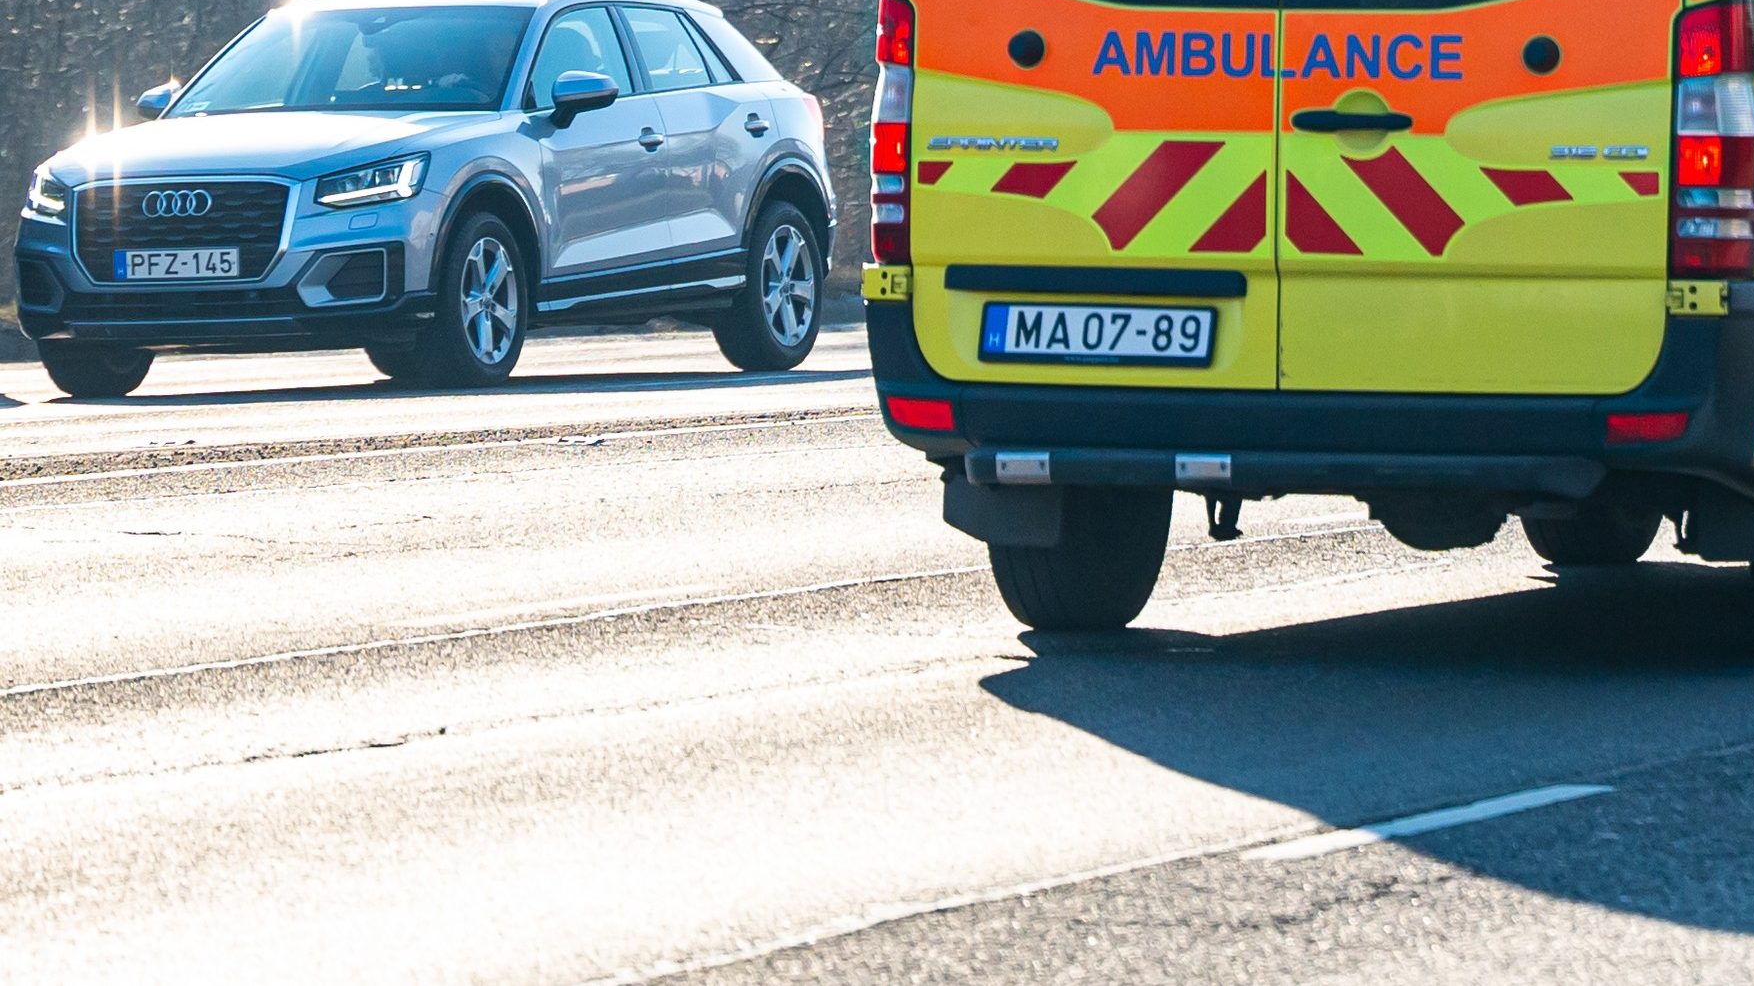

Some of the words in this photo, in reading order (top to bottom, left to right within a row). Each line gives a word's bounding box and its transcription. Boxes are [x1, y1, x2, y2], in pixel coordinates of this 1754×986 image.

[1092, 30, 1464, 80] AMBULANCE
[131, 252, 232, 275] PFZ-145
[1014, 311, 1071, 350] MA
[1081, 312, 1202, 353] 07-89
